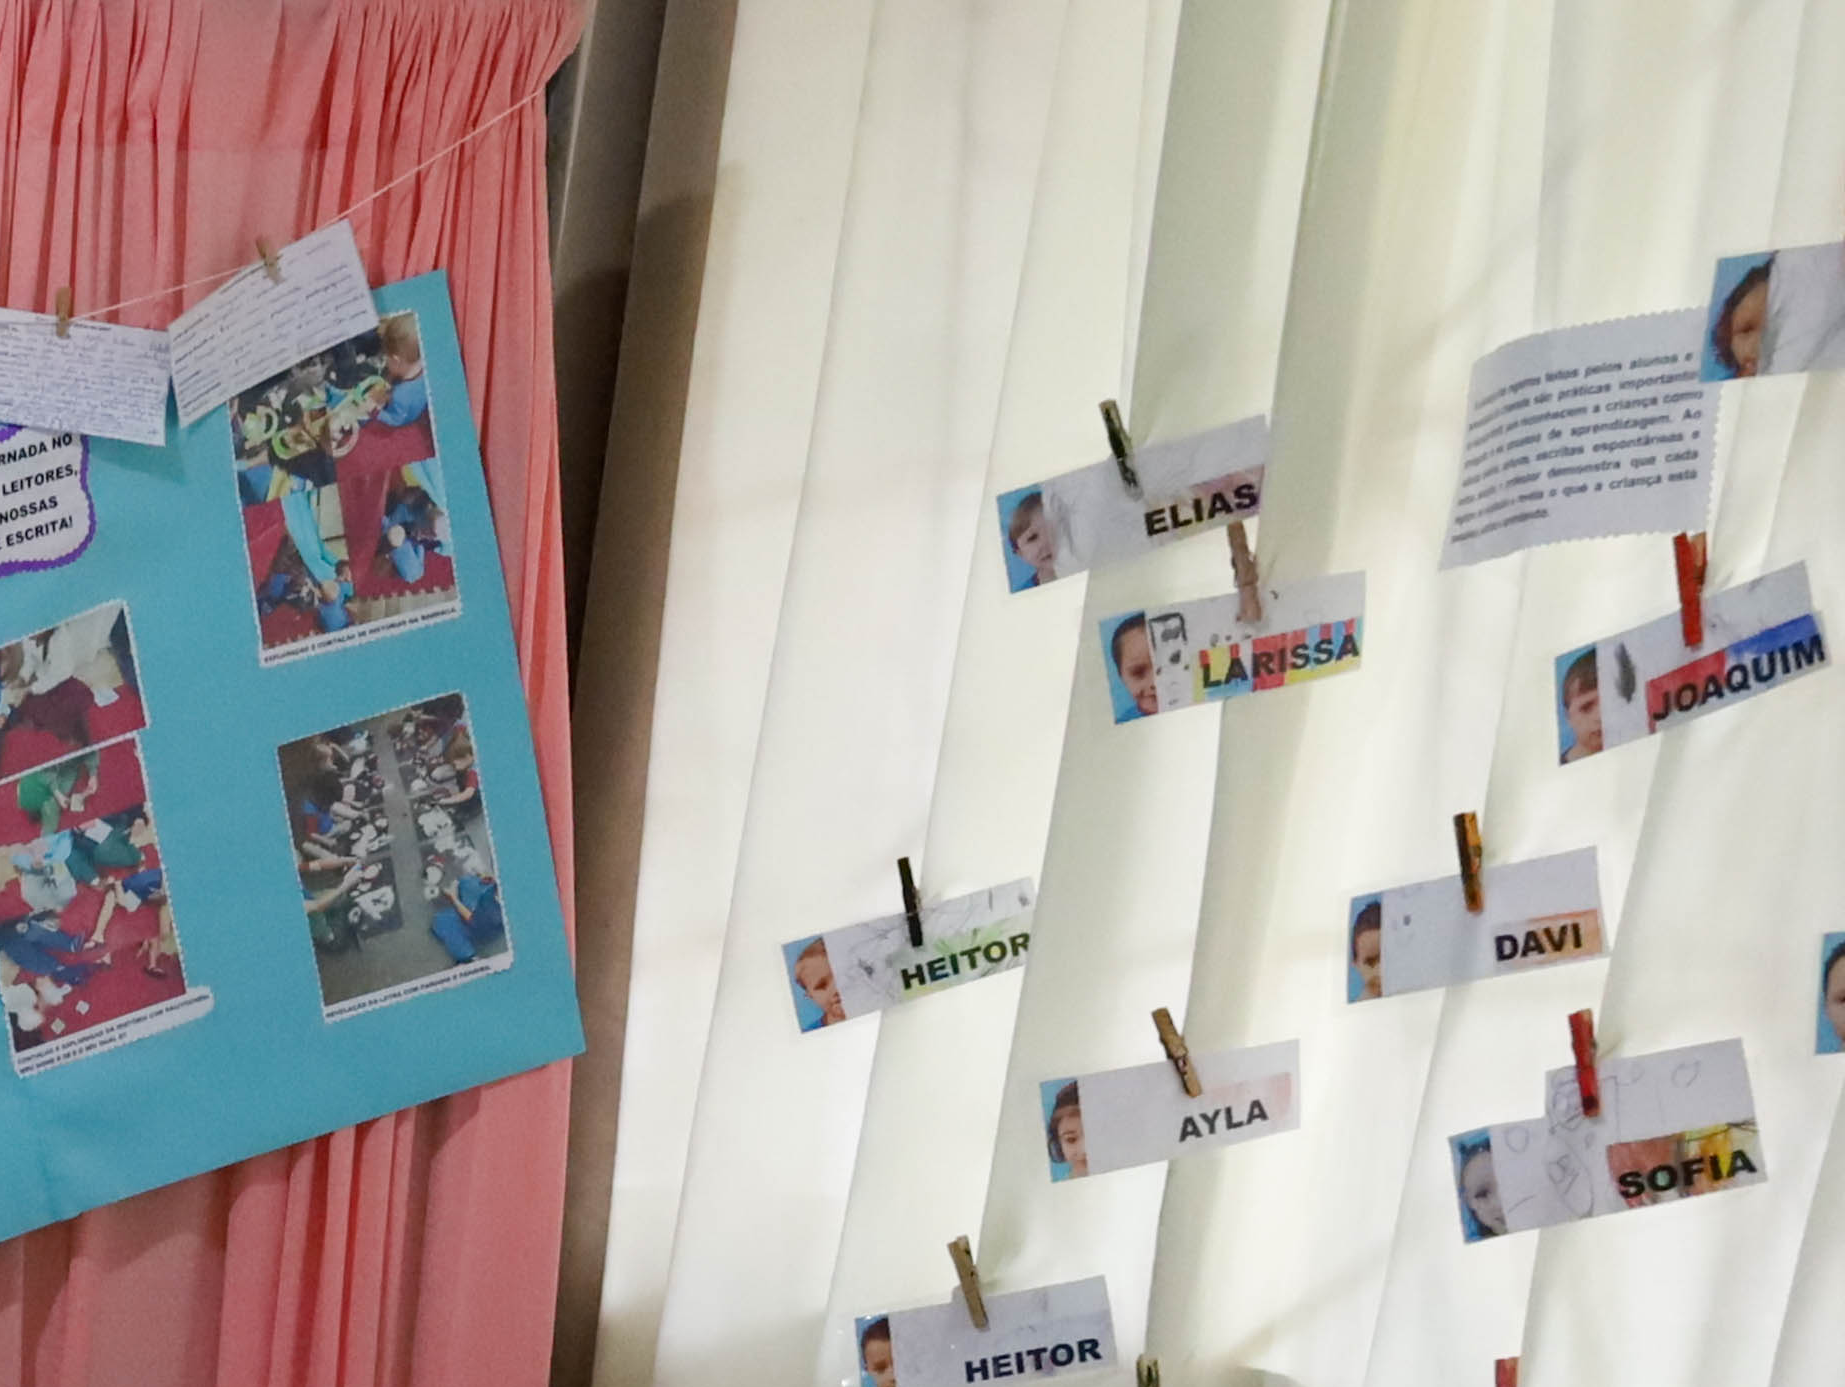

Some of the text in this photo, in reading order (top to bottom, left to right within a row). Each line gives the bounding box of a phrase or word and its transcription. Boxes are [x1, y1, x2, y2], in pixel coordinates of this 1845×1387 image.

[52, 433, 73, 450] NO
[2, 465, 78, 497] LEITORES,
[6, 515, 73, 547] ESCRITA!
[1143, 482, 1260, 536] ELIAS
[1200, 632, 1362, 690] LARISSA
[1649, 633, 1826, 726] JOAQUIM
[899, 931, 1033, 992] HEITOR
[1494, 922, 1585, 964] DAVI
[1177, 1099, 1270, 1144] AYLA
[1616, 1148, 1759, 1200] SOFIA
[964, 1337, 1102, 1384] HEITOR
